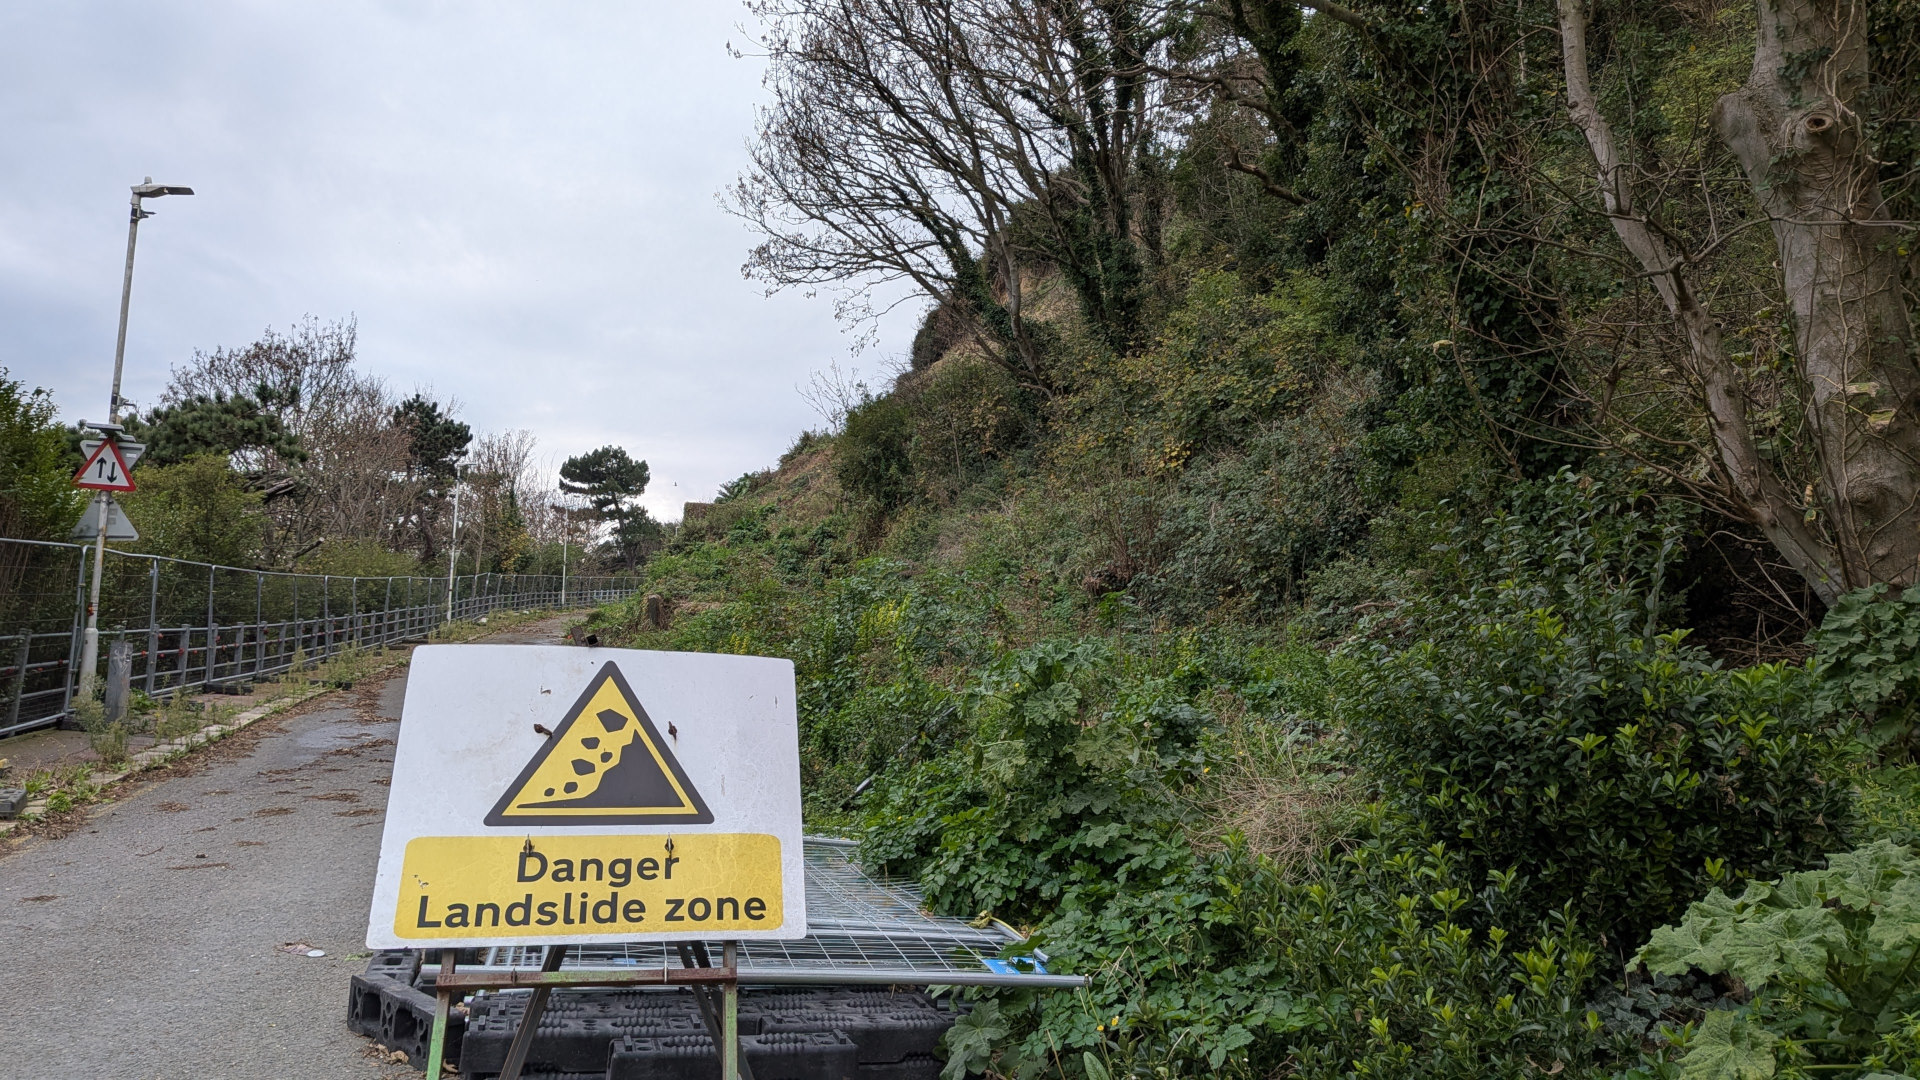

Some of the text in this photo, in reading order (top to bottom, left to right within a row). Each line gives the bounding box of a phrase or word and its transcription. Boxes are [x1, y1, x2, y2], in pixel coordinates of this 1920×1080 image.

[516, 851, 680, 888] Danger
[416, 892, 767, 928] Landslide zone
